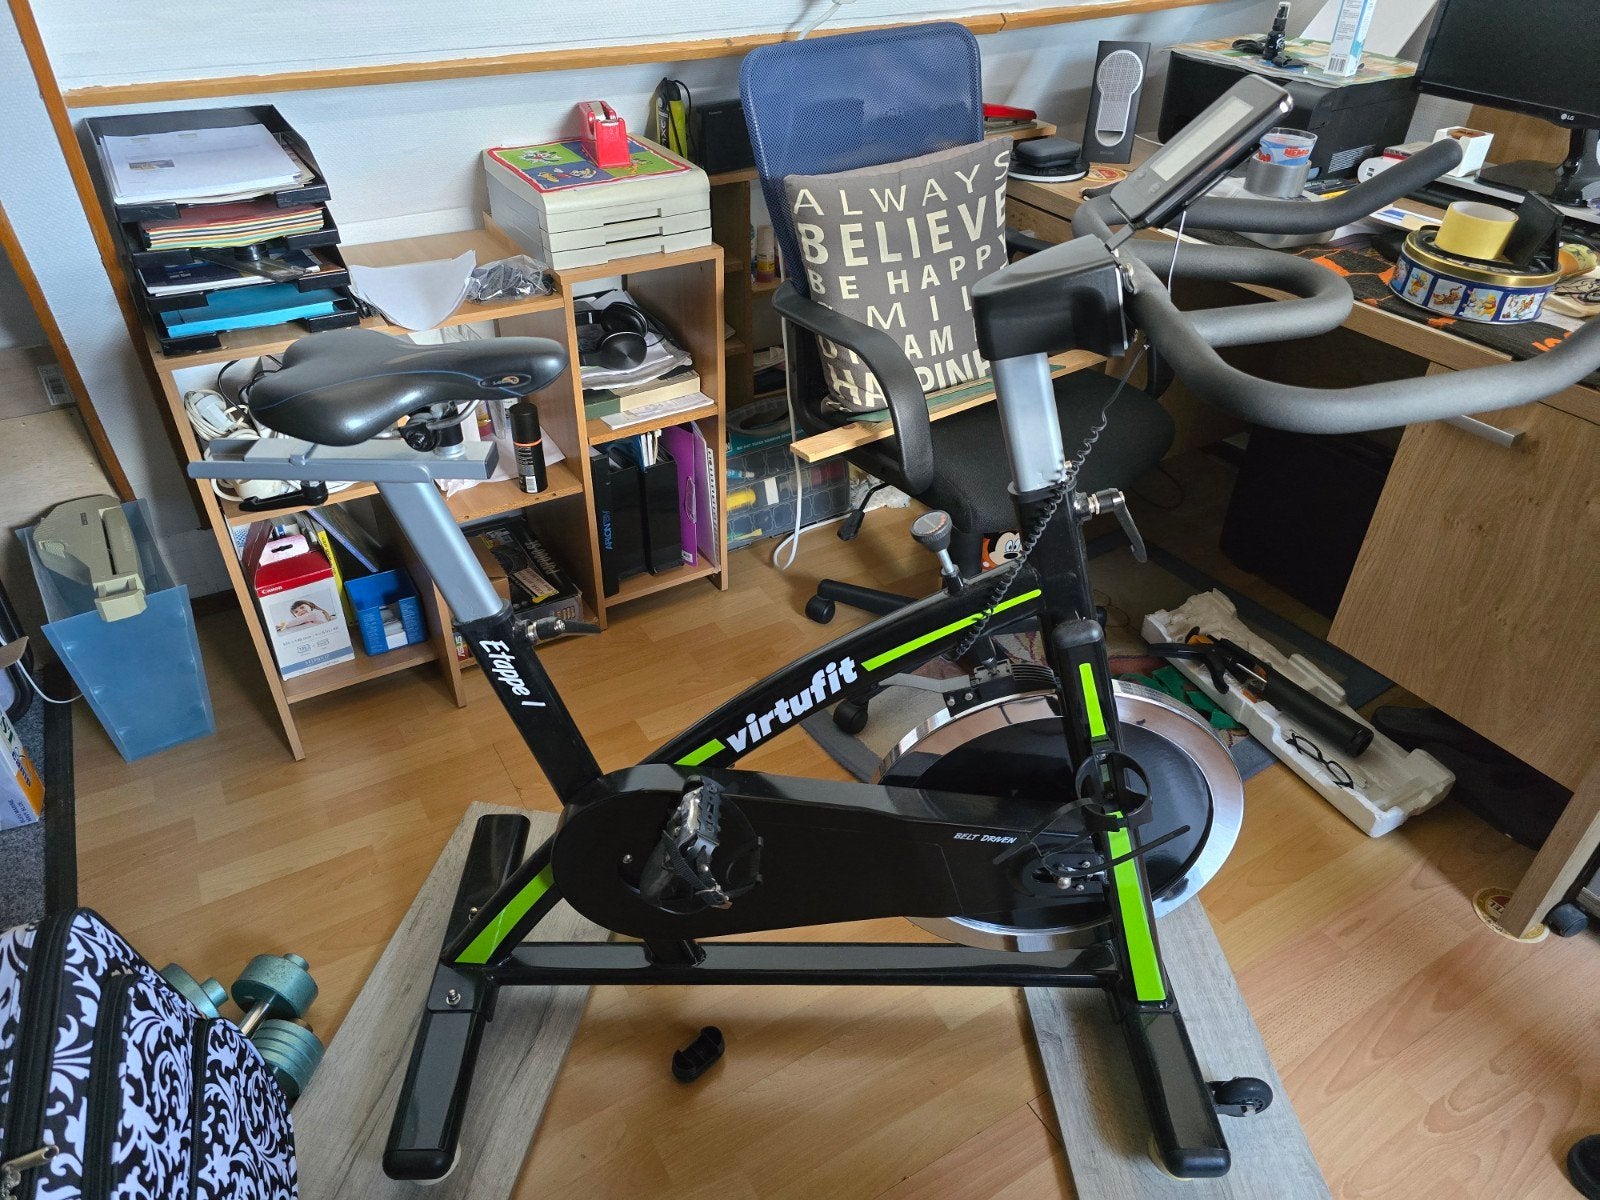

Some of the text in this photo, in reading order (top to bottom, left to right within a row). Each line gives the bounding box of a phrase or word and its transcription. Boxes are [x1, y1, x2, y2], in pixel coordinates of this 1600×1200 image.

[793, 150, 1010, 216] ALWAYS
[798, 184, 1007, 267] BELIEVE
[807, 269, 859, 300] BE
[261, 585, 283, 595] Canon
[479, 640, 531, 696] Etappe
[726, 656, 858, 753] virtufit
[953, 832, 1018, 844] BELT DRIVEN
